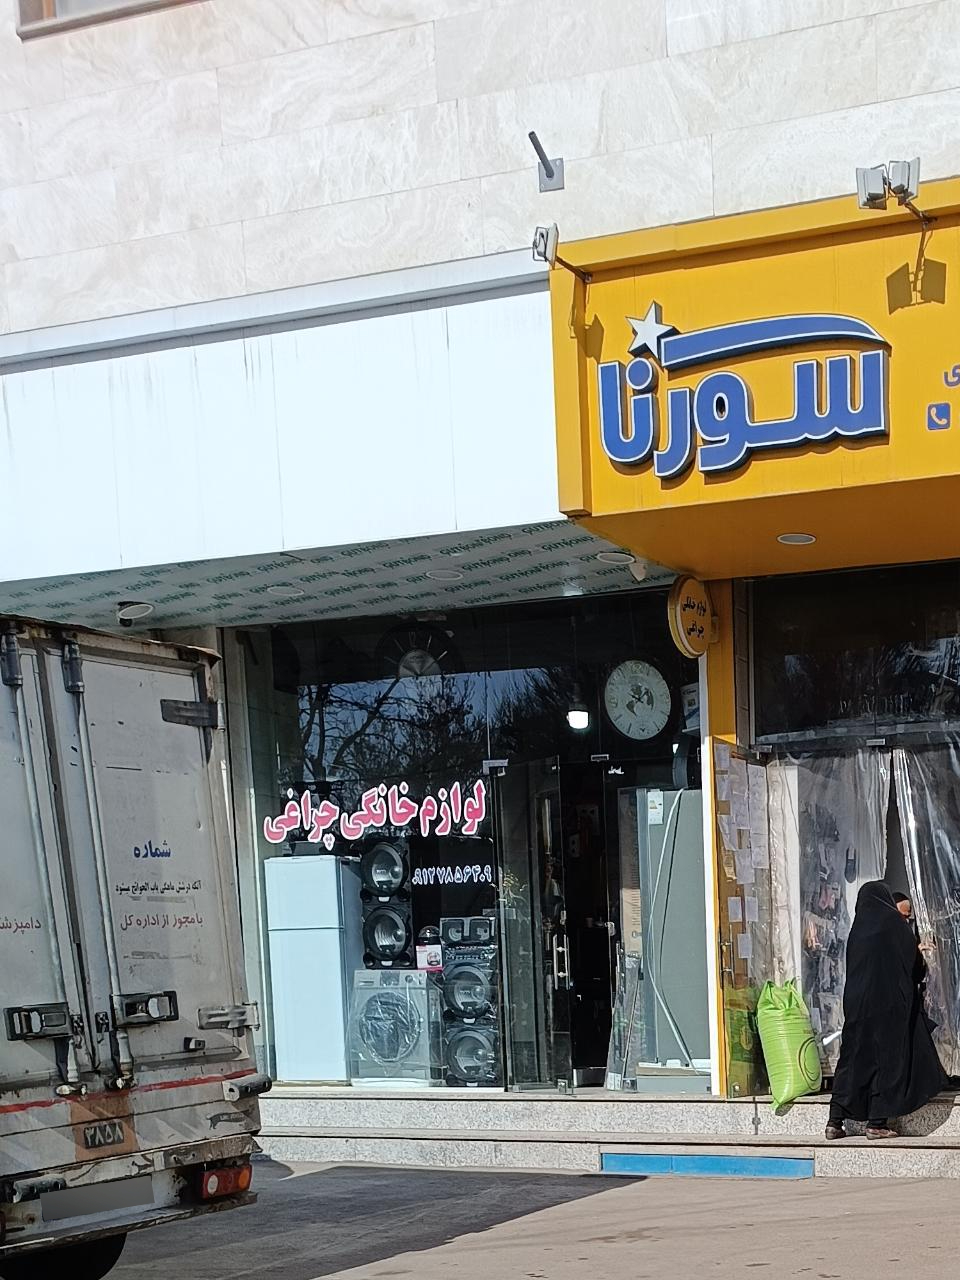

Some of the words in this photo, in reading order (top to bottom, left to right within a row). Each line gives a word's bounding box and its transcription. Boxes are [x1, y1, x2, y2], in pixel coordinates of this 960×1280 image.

[597, 350, 890, 478] سورنا
[340, 781, 418, 840] خانگی
[419, 779, 487, 837] لوازم
[263, 787, 340, 851] چراغی
[133, 839, 171, 858] شماره
[0, 916, 42, 934] دامپزش
[120, 914, 134, 931] کل
[136, 913, 160, 929] اداره
[161, 914, 169, 929] از
